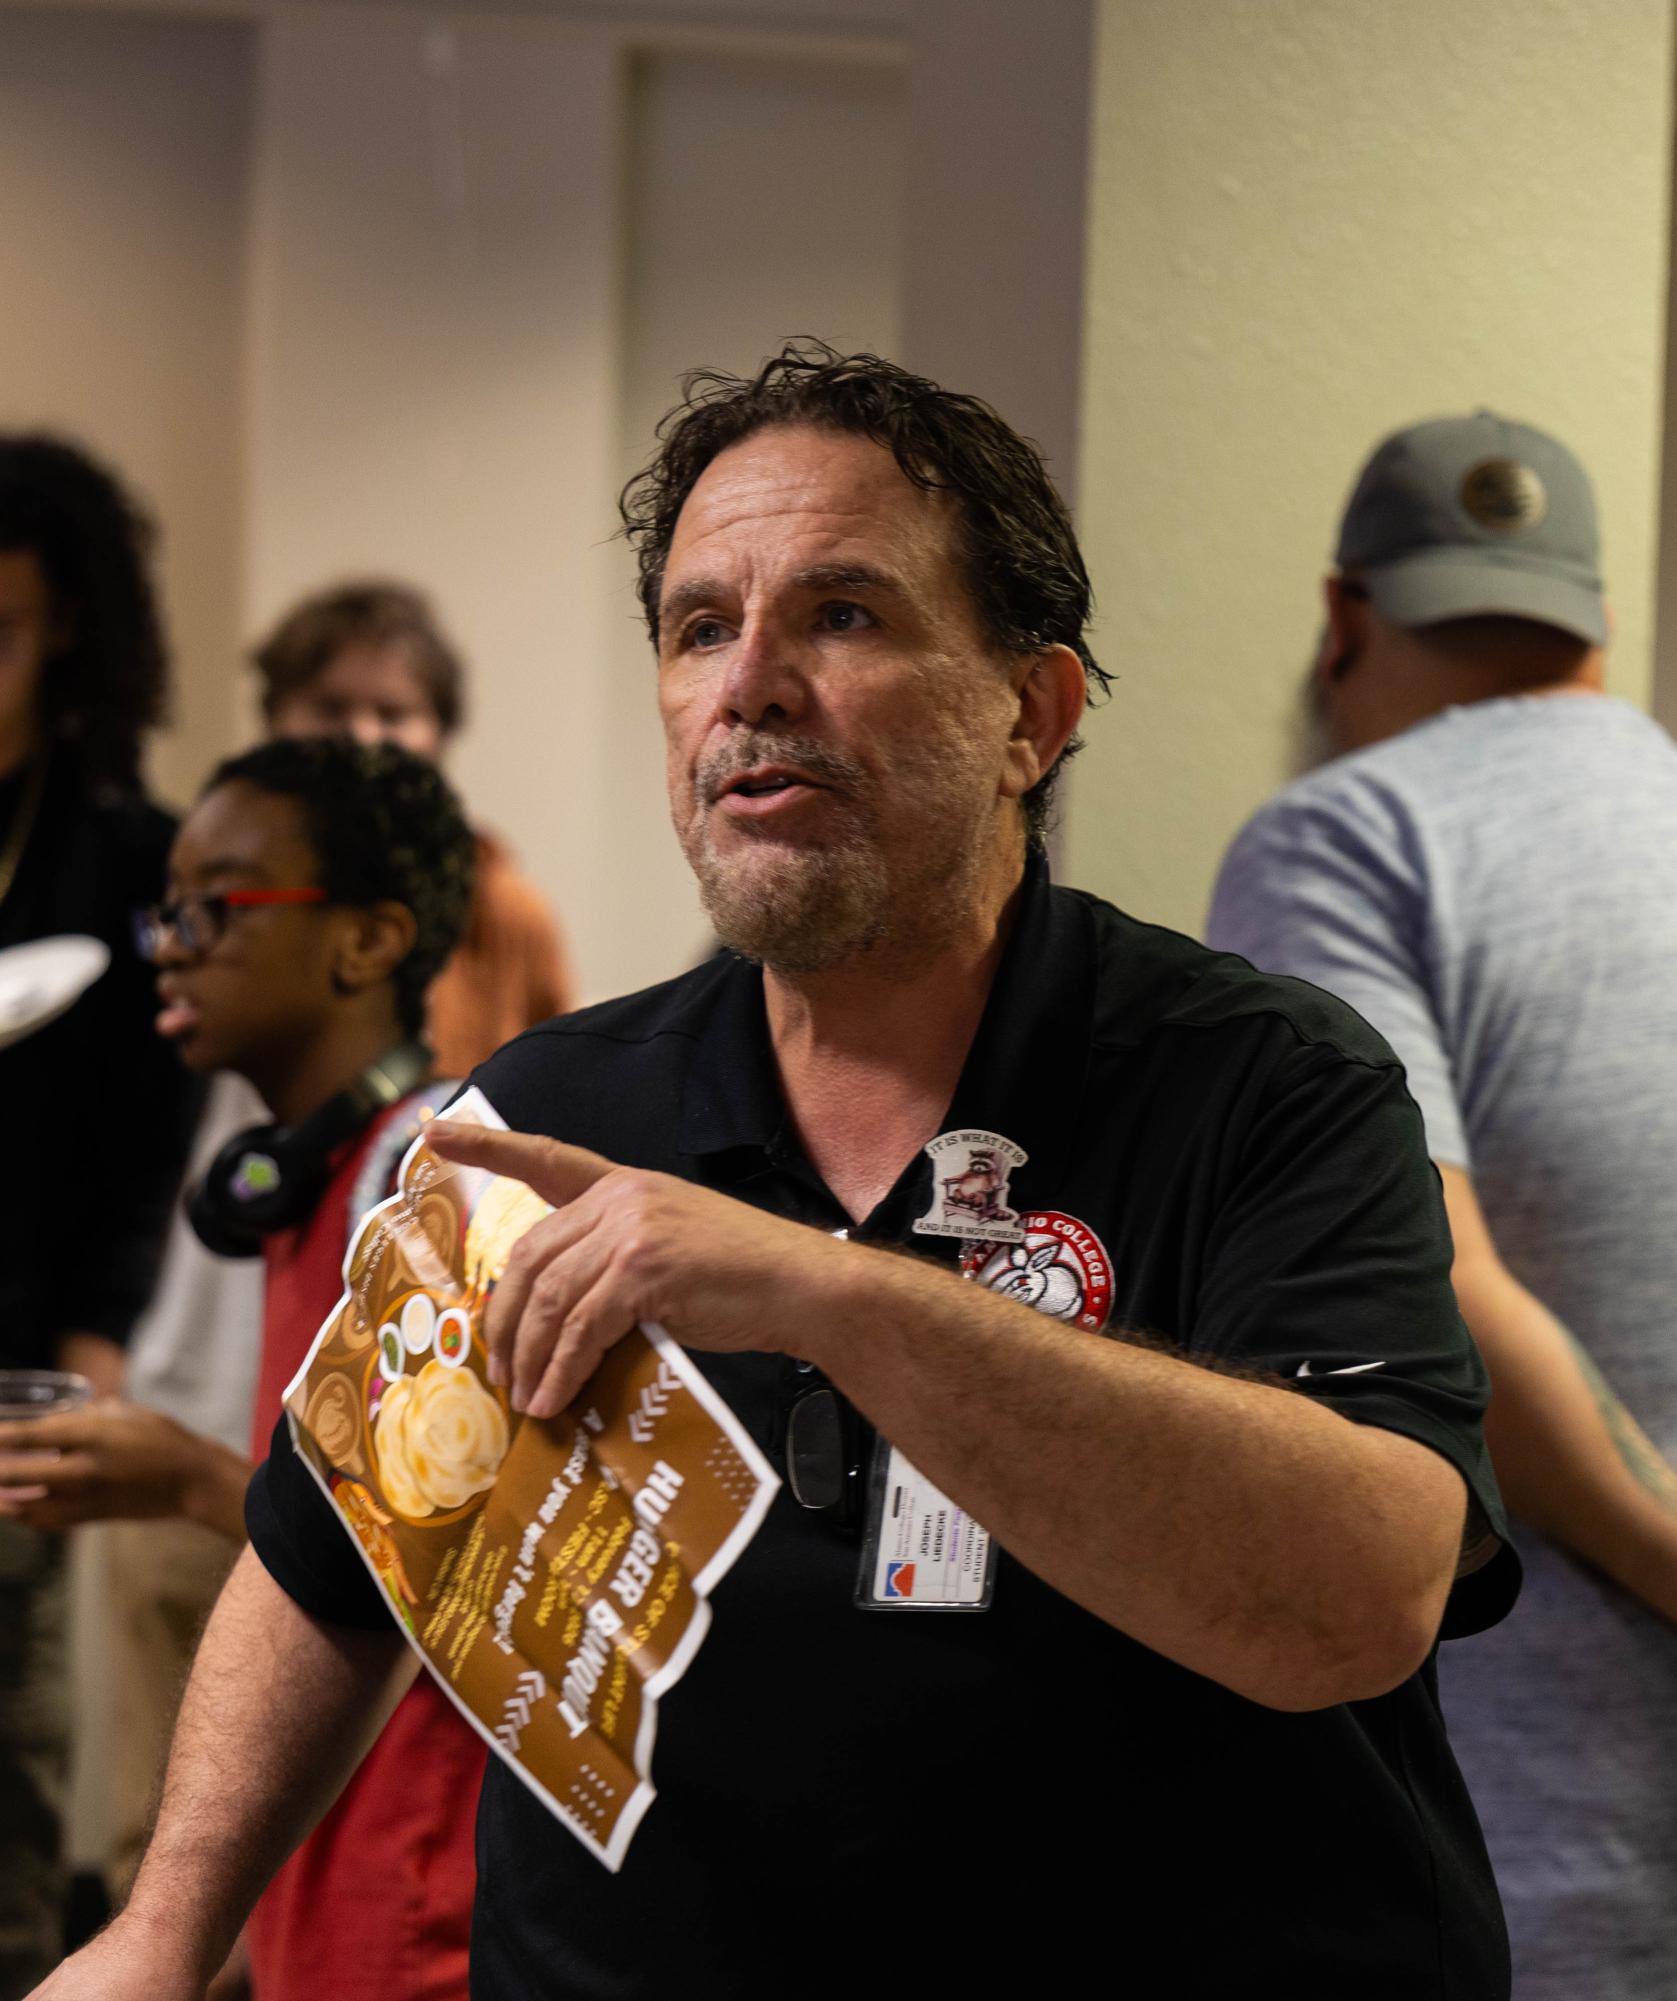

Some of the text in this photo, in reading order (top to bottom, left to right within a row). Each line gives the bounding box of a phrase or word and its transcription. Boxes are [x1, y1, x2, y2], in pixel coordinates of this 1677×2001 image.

[930, 1133, 1025, 1163] IT IS WHAT IT IS
[917, 1223, 1023, 1240] AND IT IS NOT GREAT
[1052, 1219, 1107, 1288] COLLEGE
[538, 1477, 573, 1524] you
[513, 1521, 547, 1584] won't
[920, 1514, 932, 1556] JOSEPH
[932, 1510, 948, 1562] LIEDECKE
[492, 1578, 527, 1656] forget!
[556, 1460, 686, 1740] HUGER BANQUT
[645, 1598, 667, 1628] OF
